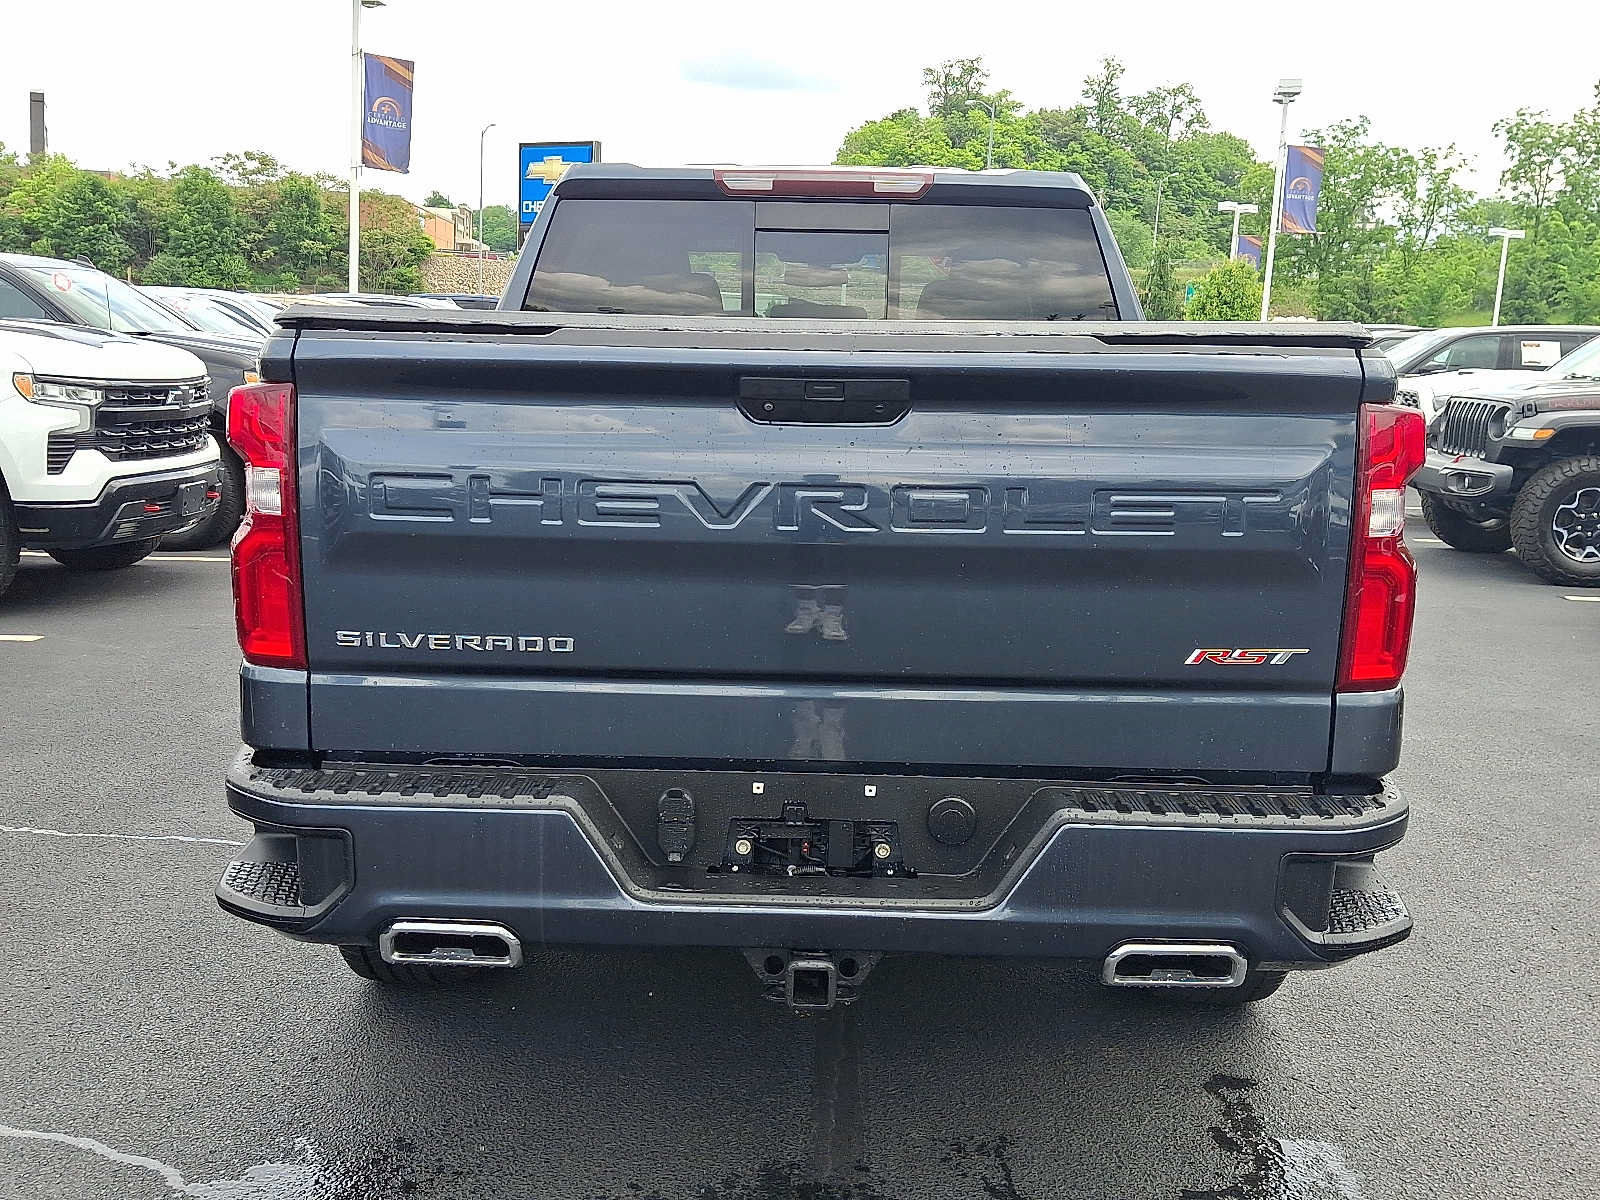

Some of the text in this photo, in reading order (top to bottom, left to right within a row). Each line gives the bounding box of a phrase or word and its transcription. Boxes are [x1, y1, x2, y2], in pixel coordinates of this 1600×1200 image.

[367, 116, 408, 129] ADVANTAGE
[367, 472, 1283, 536] CHEVROLET
[335, 630, 575, 653] SILVERADO
[1184, 648, 1311, 665] RST
